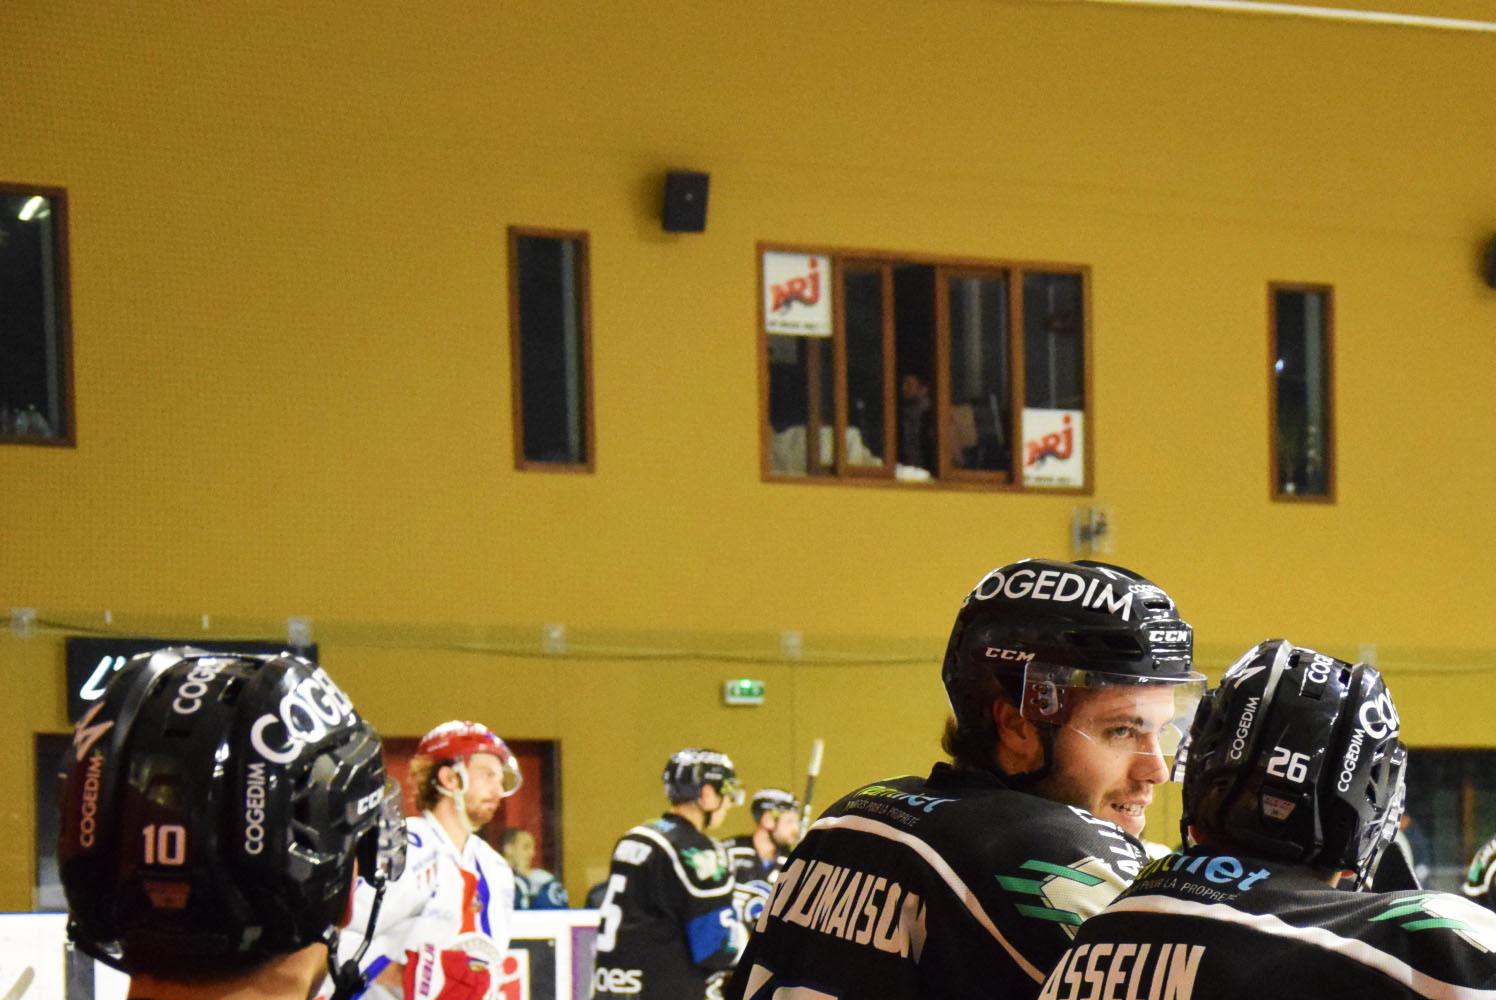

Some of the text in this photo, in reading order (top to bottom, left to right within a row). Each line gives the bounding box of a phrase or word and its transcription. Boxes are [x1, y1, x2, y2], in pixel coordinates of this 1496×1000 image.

[964, 568, 1134, 622] OGEDIM
[984, 647, 1036, 662] CCM
[1149, 631, 1189, 642] CCM
[1230, 697, 1260, 760] COGEDIM
[1266, 746, 1311, 783] 26
[1337, 729, 1366, 792] COGEDIM
[80, 755, 104, 847] COGEDIM
[244, 762, 267, 855] COGEDIM
[142, 824, 187, 866] 10
